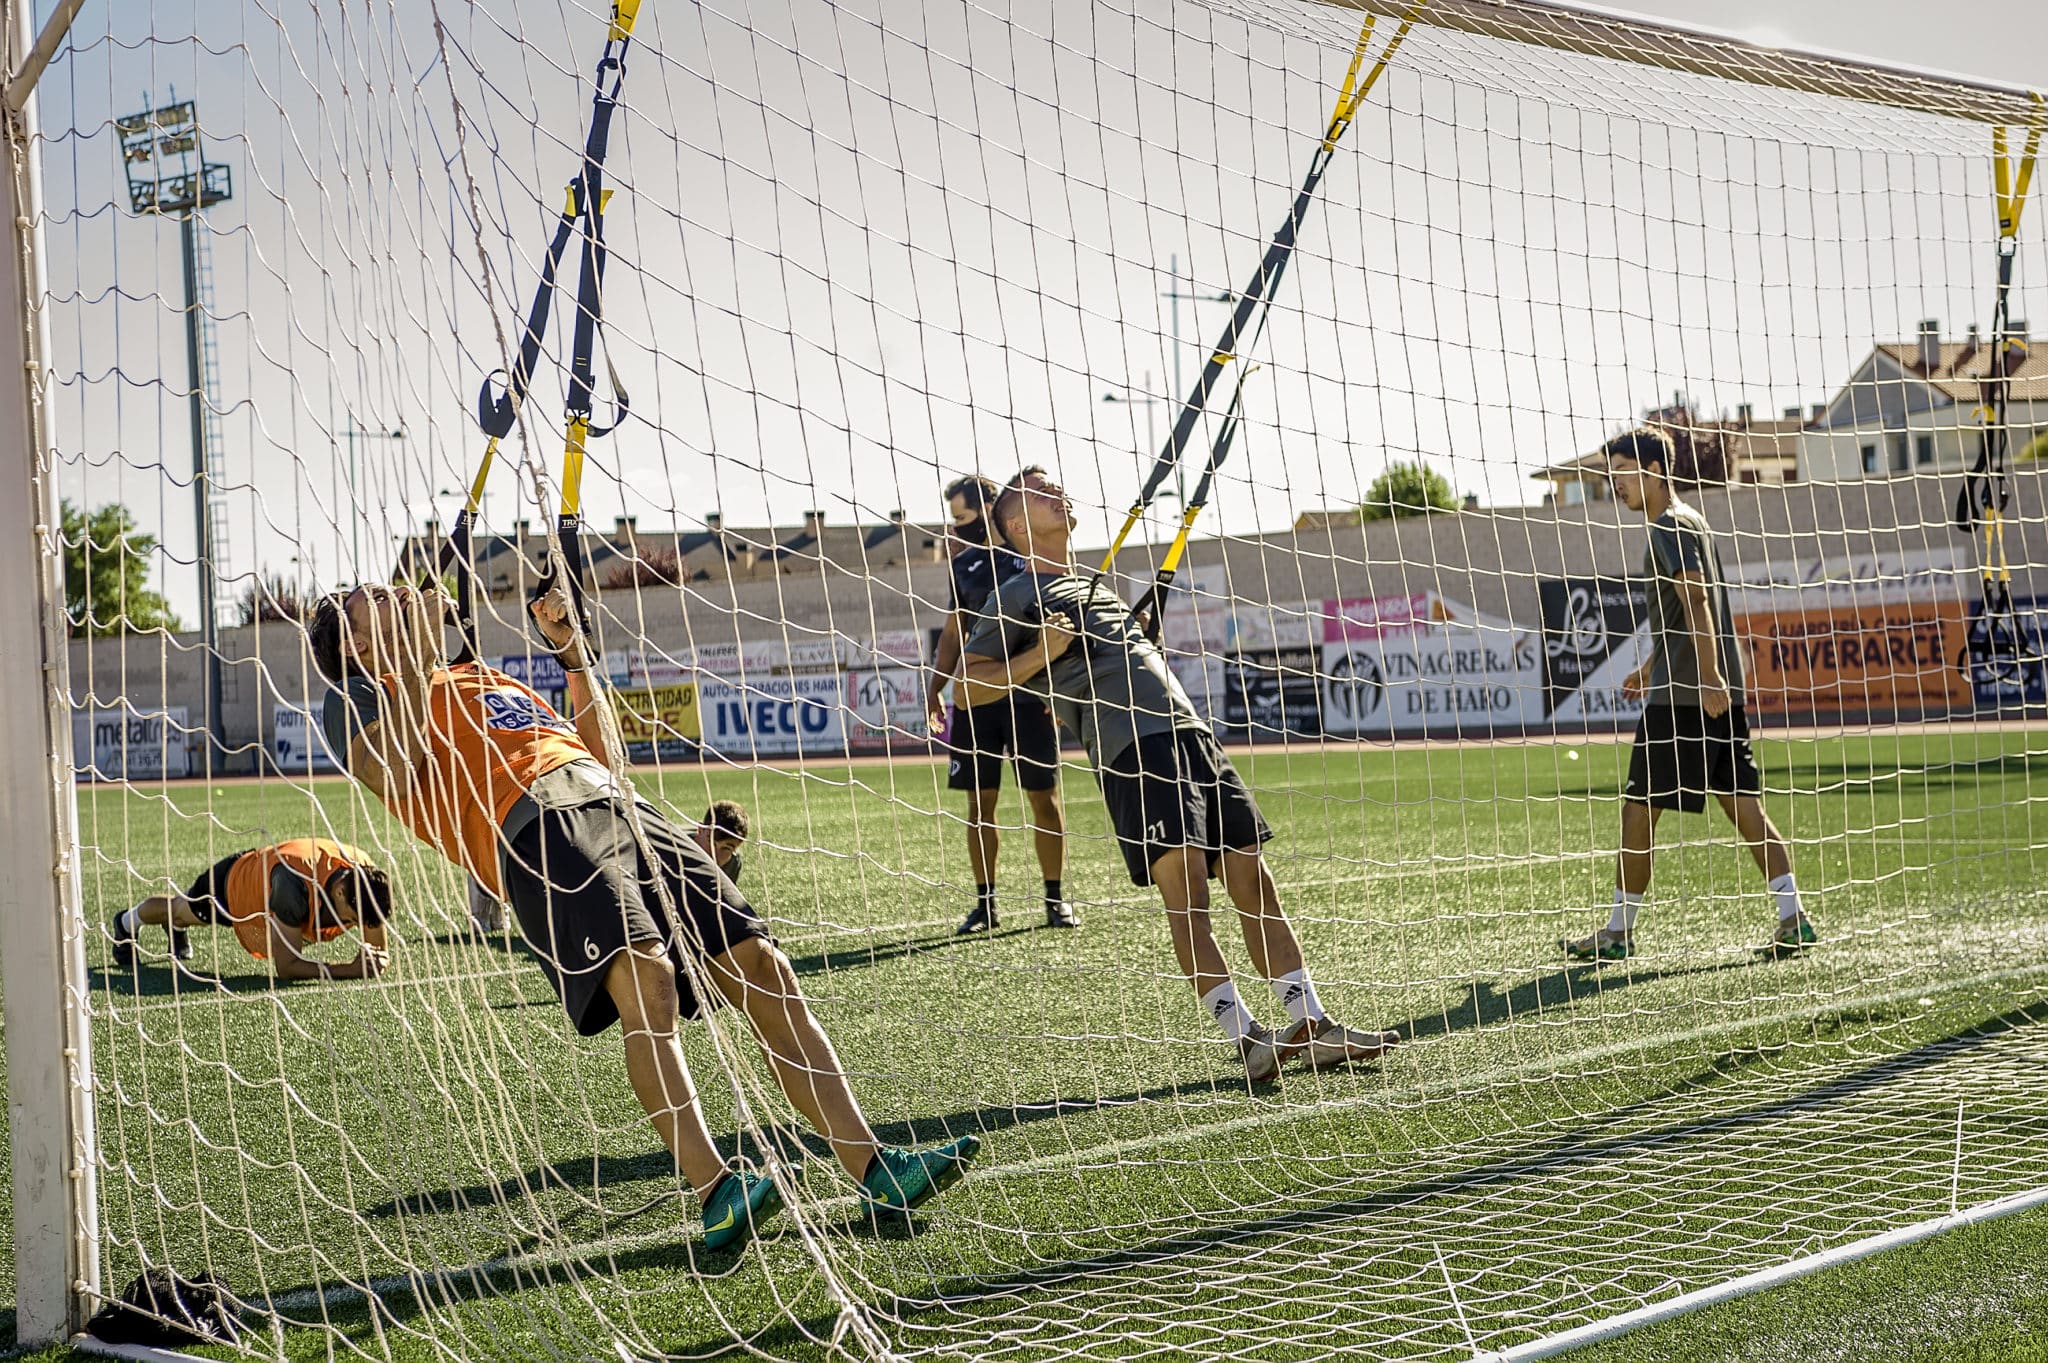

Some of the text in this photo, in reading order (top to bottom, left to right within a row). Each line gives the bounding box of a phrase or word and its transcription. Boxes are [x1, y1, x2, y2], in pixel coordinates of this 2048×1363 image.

[1383, 645, 1535, 676] VINAGRERAS
[1770, 634, 1947, 673] RIVERARCE
[702, 680, 810, 699] AUTO-RPARACIONES
[812, 678, 844, 692] HARO
[1407, 687, 1512, 715] DE HARO
[716, 696, 829, 737] IVECO
[1148, 820, 1166, 842] 21
[584, 936, 600, 960] 6
